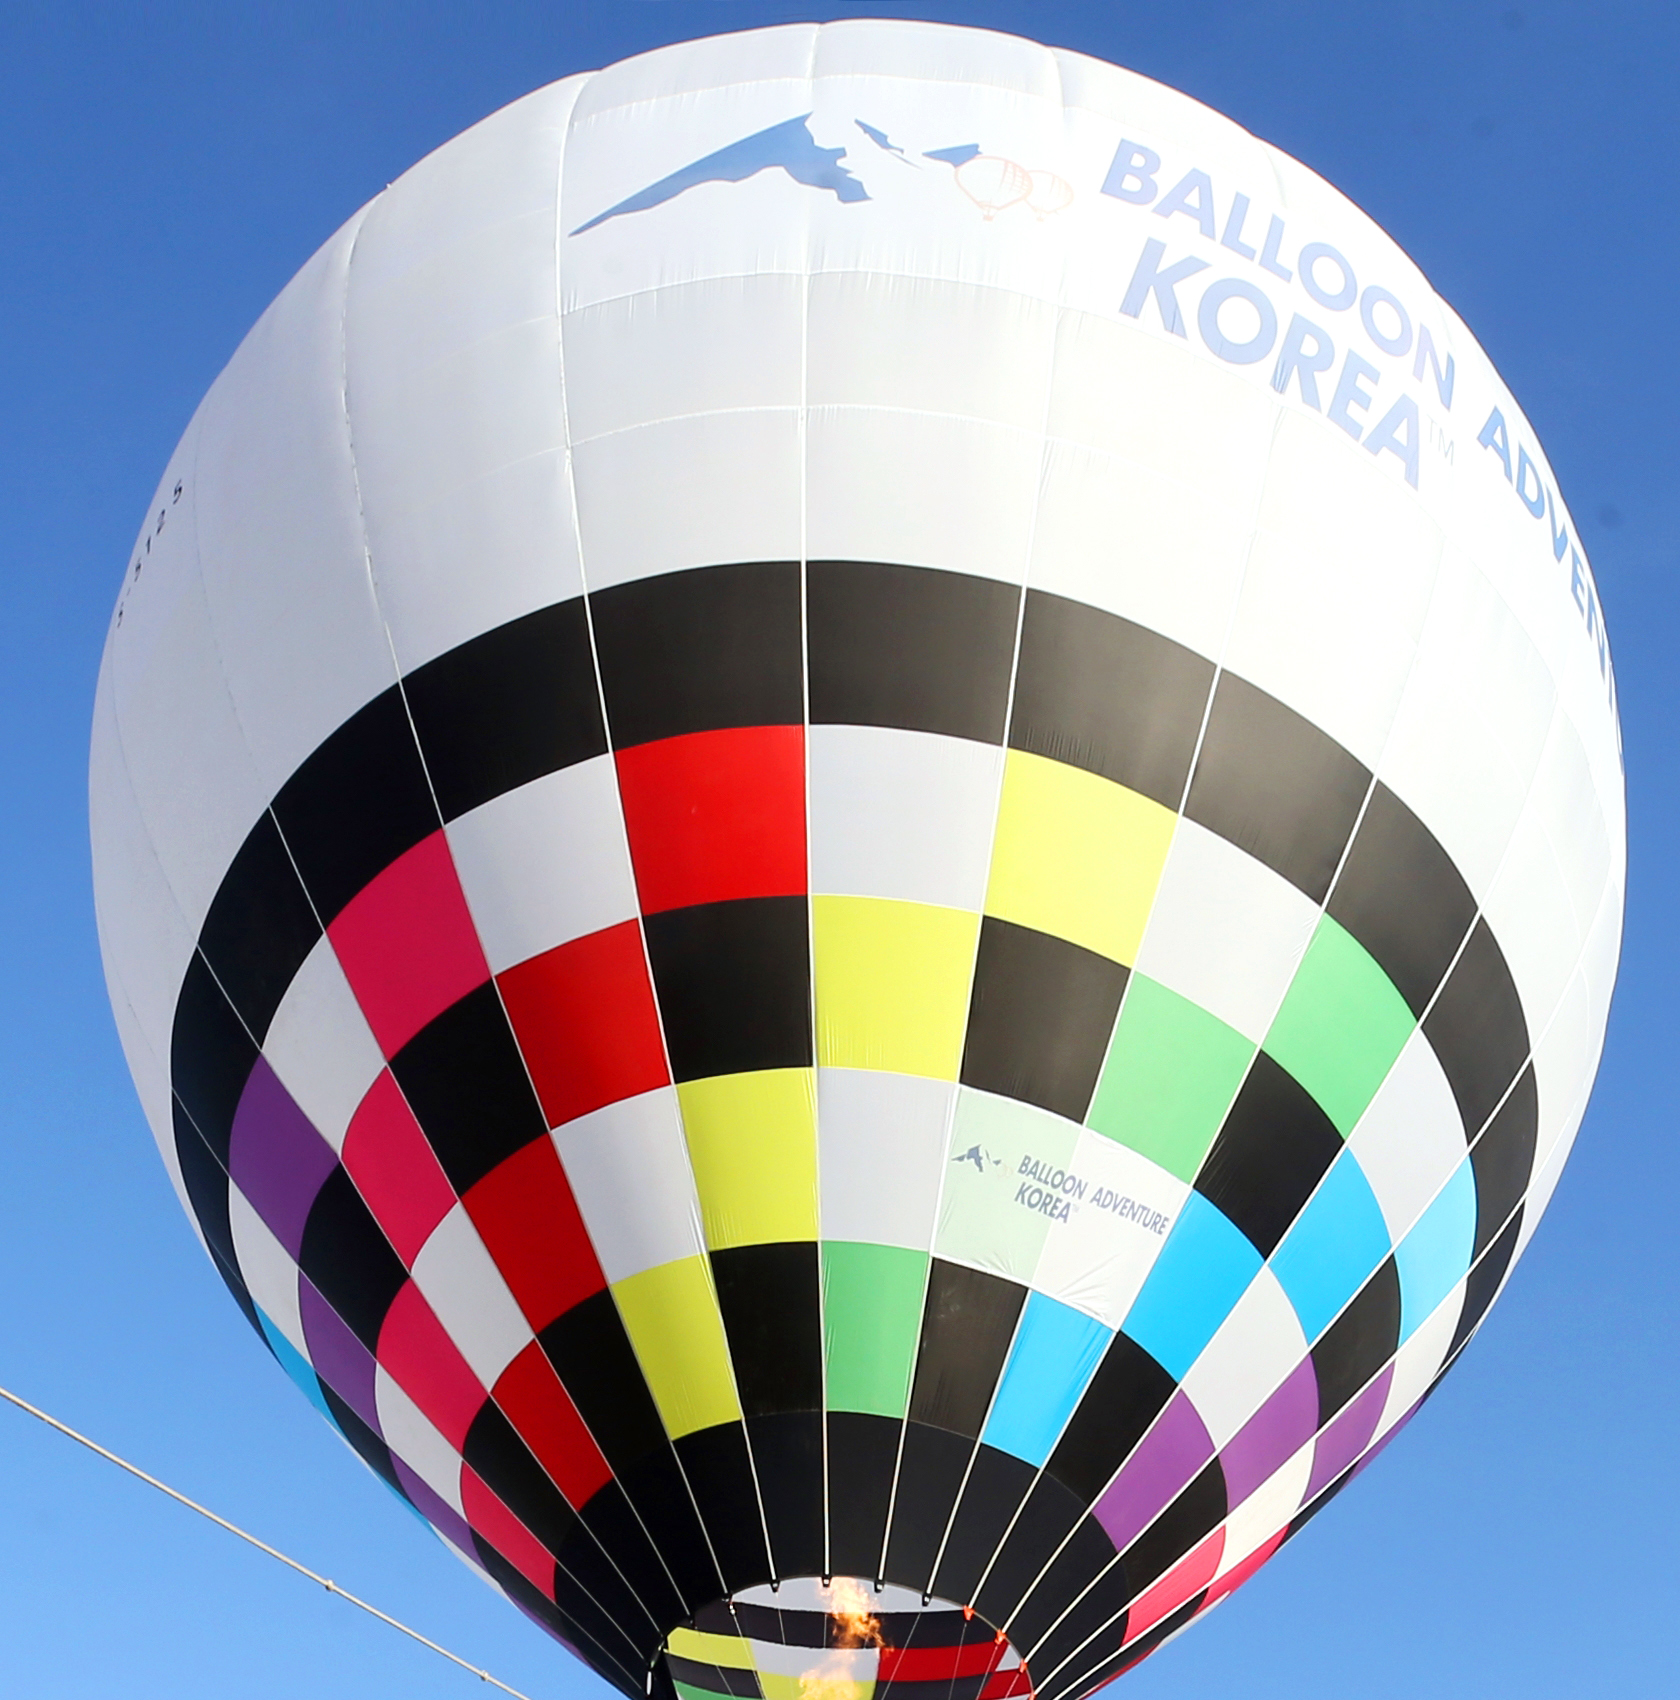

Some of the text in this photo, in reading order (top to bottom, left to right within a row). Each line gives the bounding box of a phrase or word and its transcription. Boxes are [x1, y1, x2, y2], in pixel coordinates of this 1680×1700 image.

[1100, 137, 1455, 412] BALLOON
[1118, 236, 1420, 492] KOREA
[1014, 1182, 1071, 1224] KOREA
[1017, 1154, 1170, 1236] BALLOON ADVENTURE
